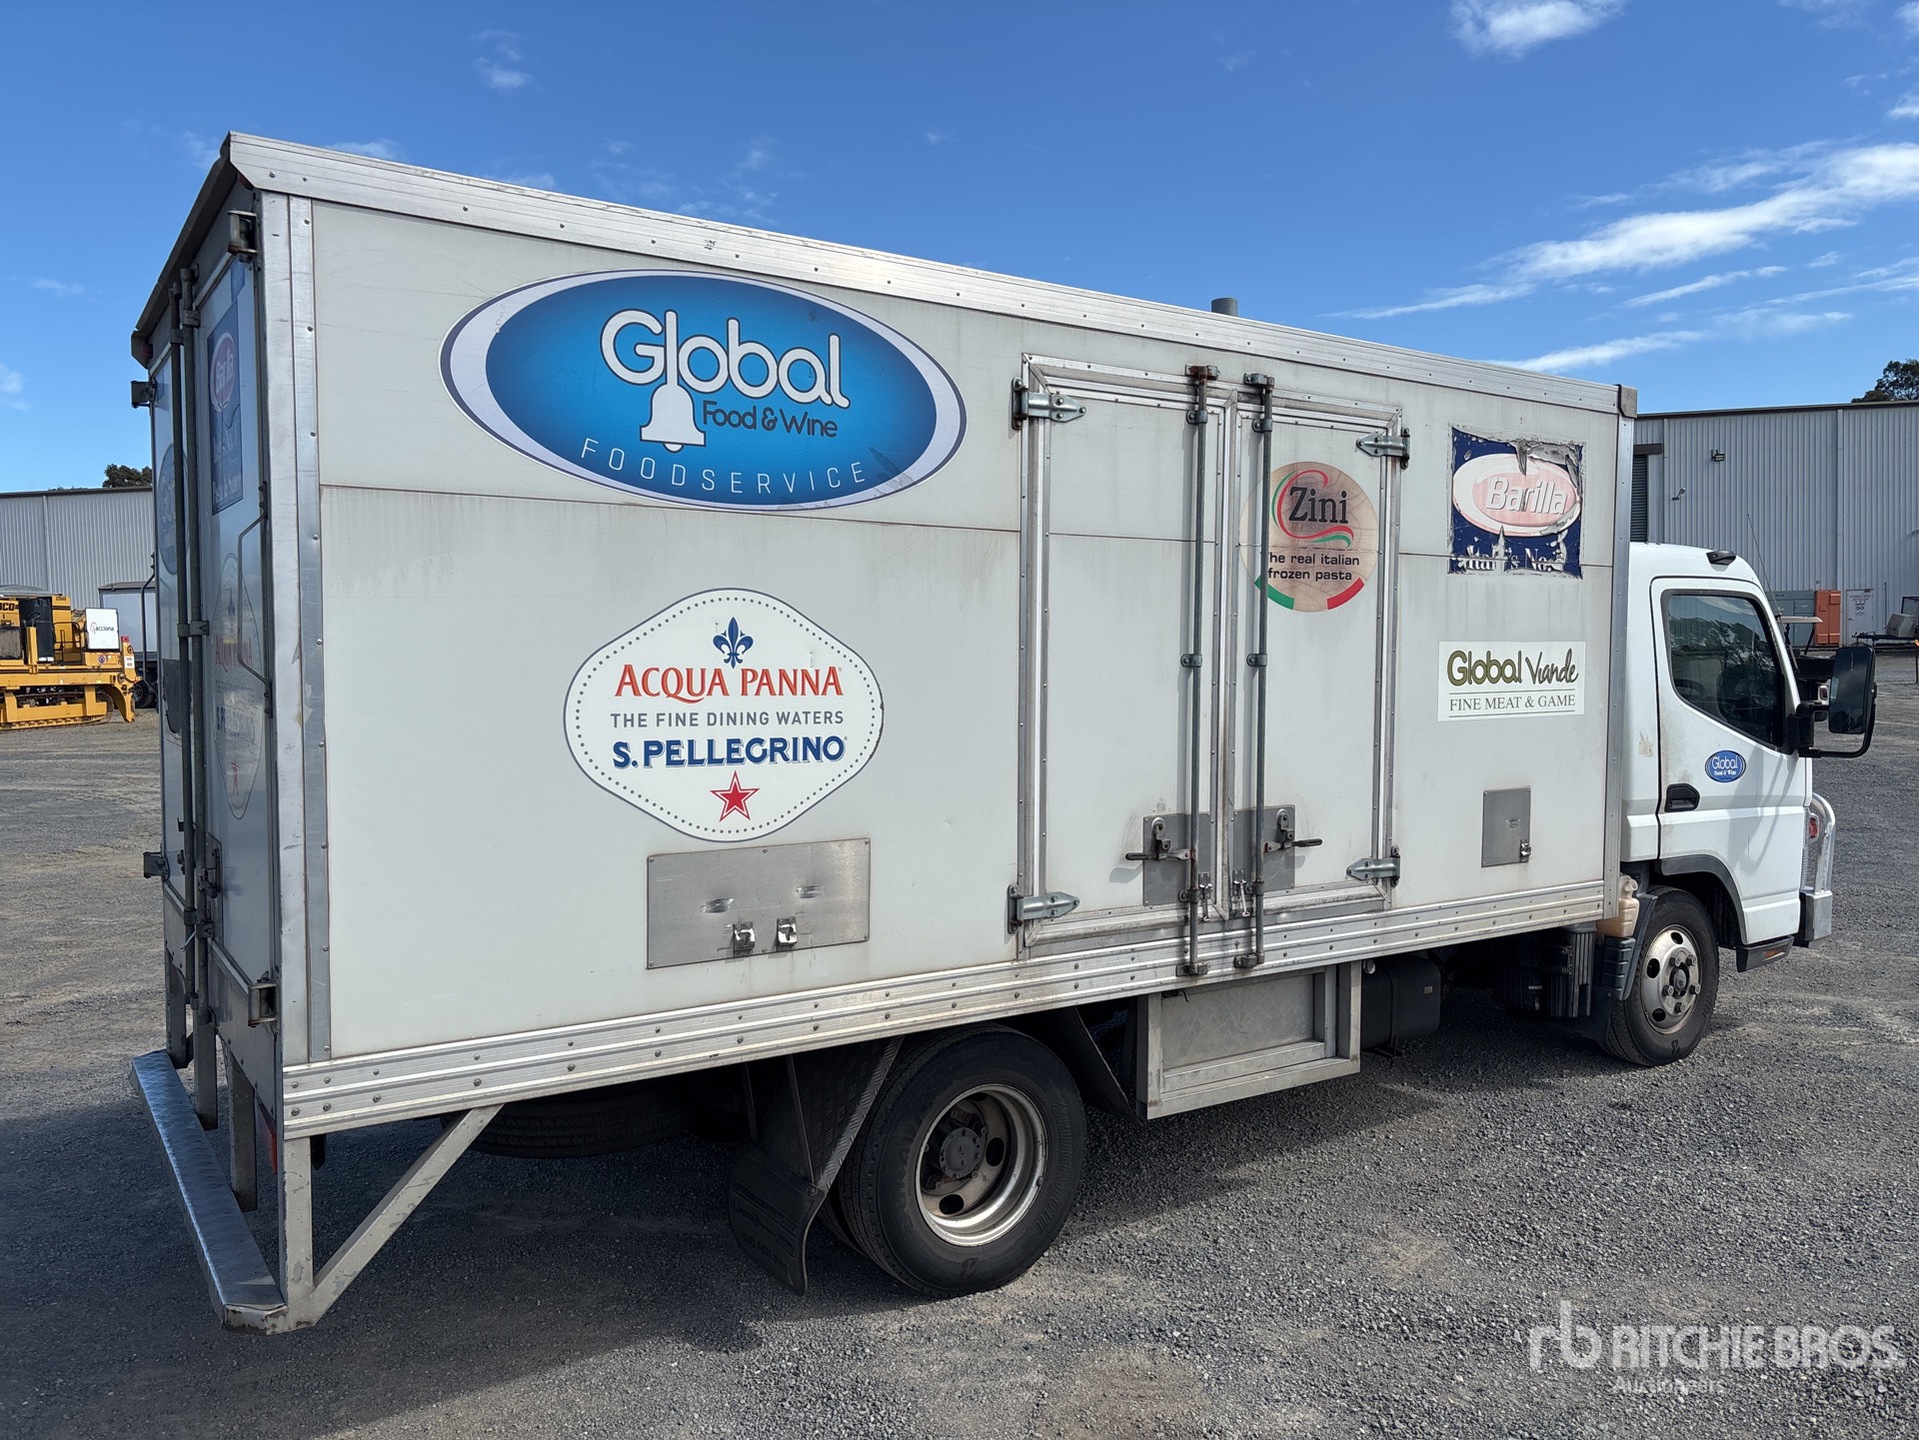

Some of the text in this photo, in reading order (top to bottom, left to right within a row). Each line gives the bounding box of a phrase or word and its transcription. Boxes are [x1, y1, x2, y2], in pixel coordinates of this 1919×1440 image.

[600, 308, 850, 409] Global
[703, 400, 838, 438] Food & Wine
[581, 437, 866, 495] FOODSERVICE
[1288, 486, 1349, 524] Zini
[1486, 475, 1568, 516] Barilla
[1267, 551, 1360, 566] he real italian
[1267, 567, 1352, 582] frozen pasta
[614, 663, 844, 704] ACQUA PANNA
[1447, 647, 1579, 687] Global Viande
[610, 709, 844, 728] THE FINE DINING WATERS
[1449, 694, 1576, 712] FINE MEAT & GAME
[1711, 755, 1738, 770] Global
